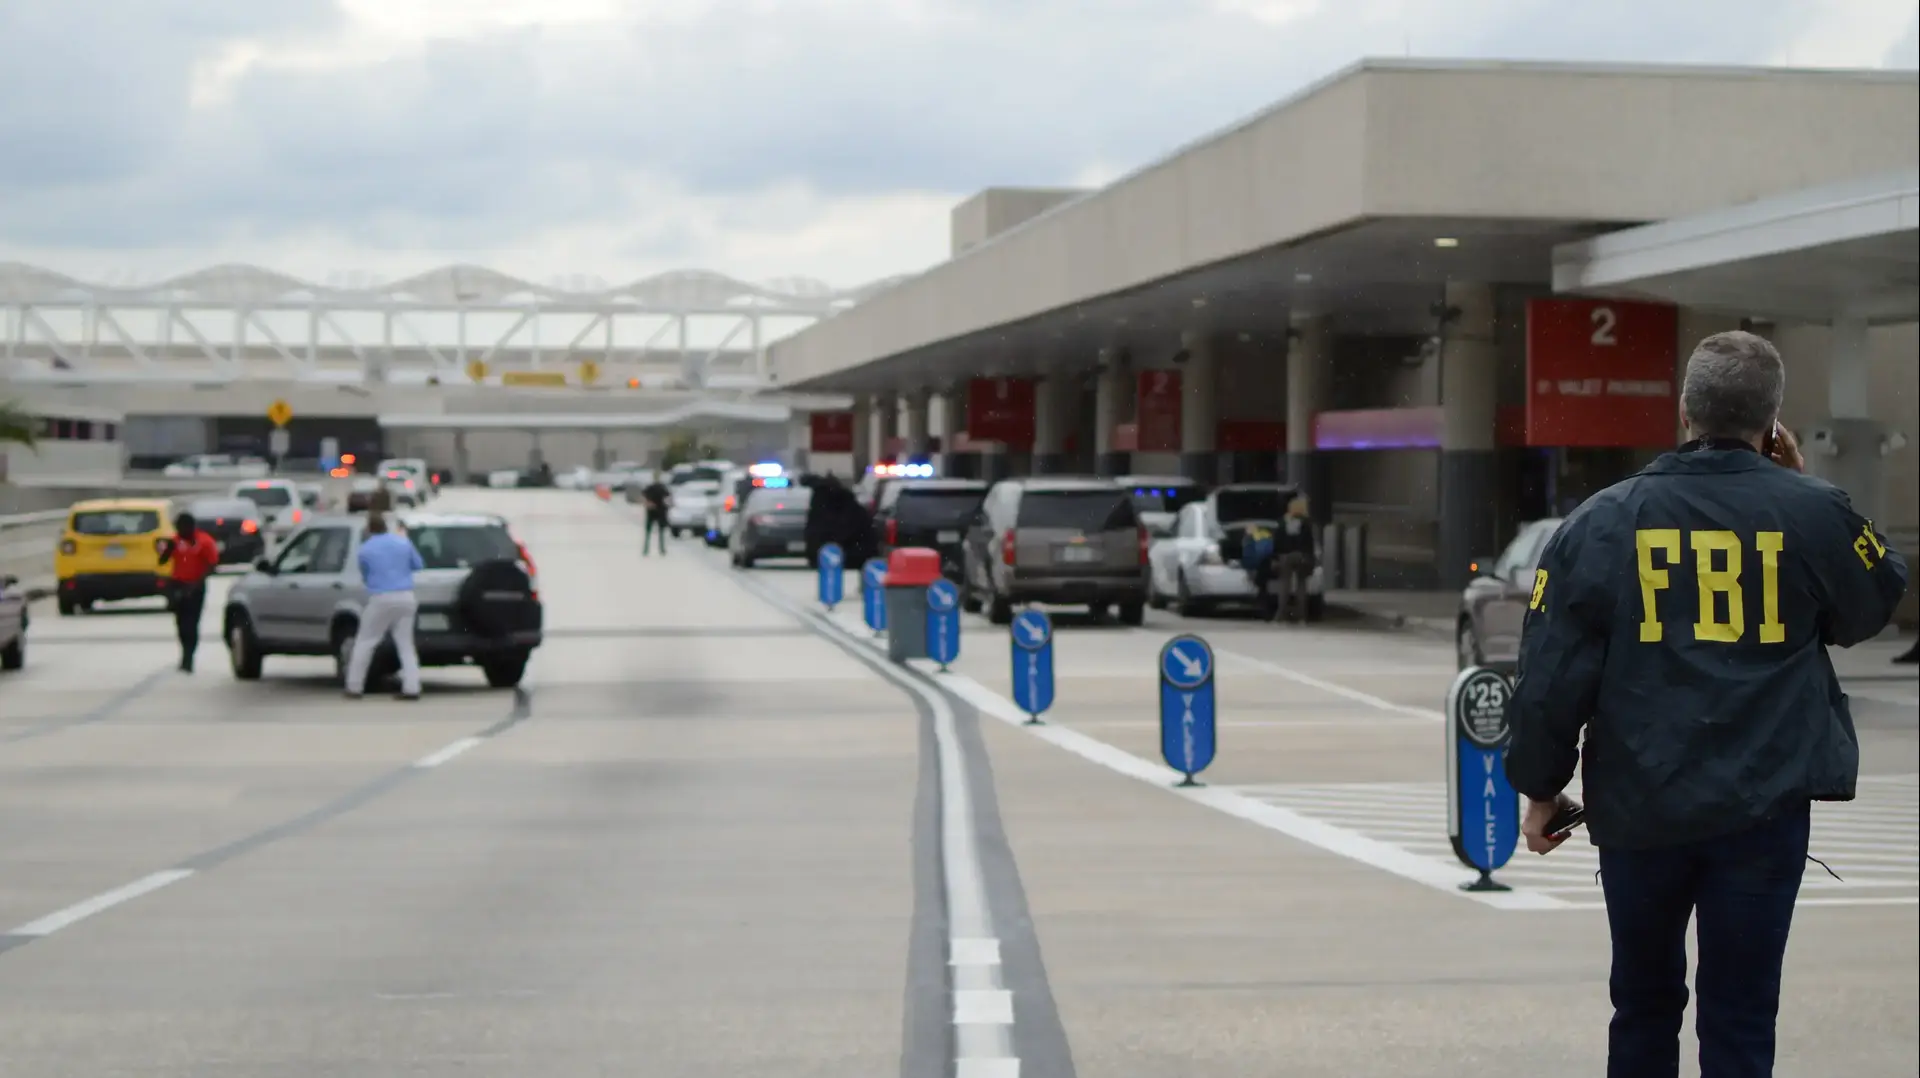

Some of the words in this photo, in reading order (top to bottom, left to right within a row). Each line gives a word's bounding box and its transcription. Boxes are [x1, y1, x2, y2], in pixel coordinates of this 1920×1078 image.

[1591, 307, 1617, 345] 2
[1636, 528, 1786, 644] FBI
[1468, 682, 1503, 708] $25
[1483, 755, 1497, 869] VALET
